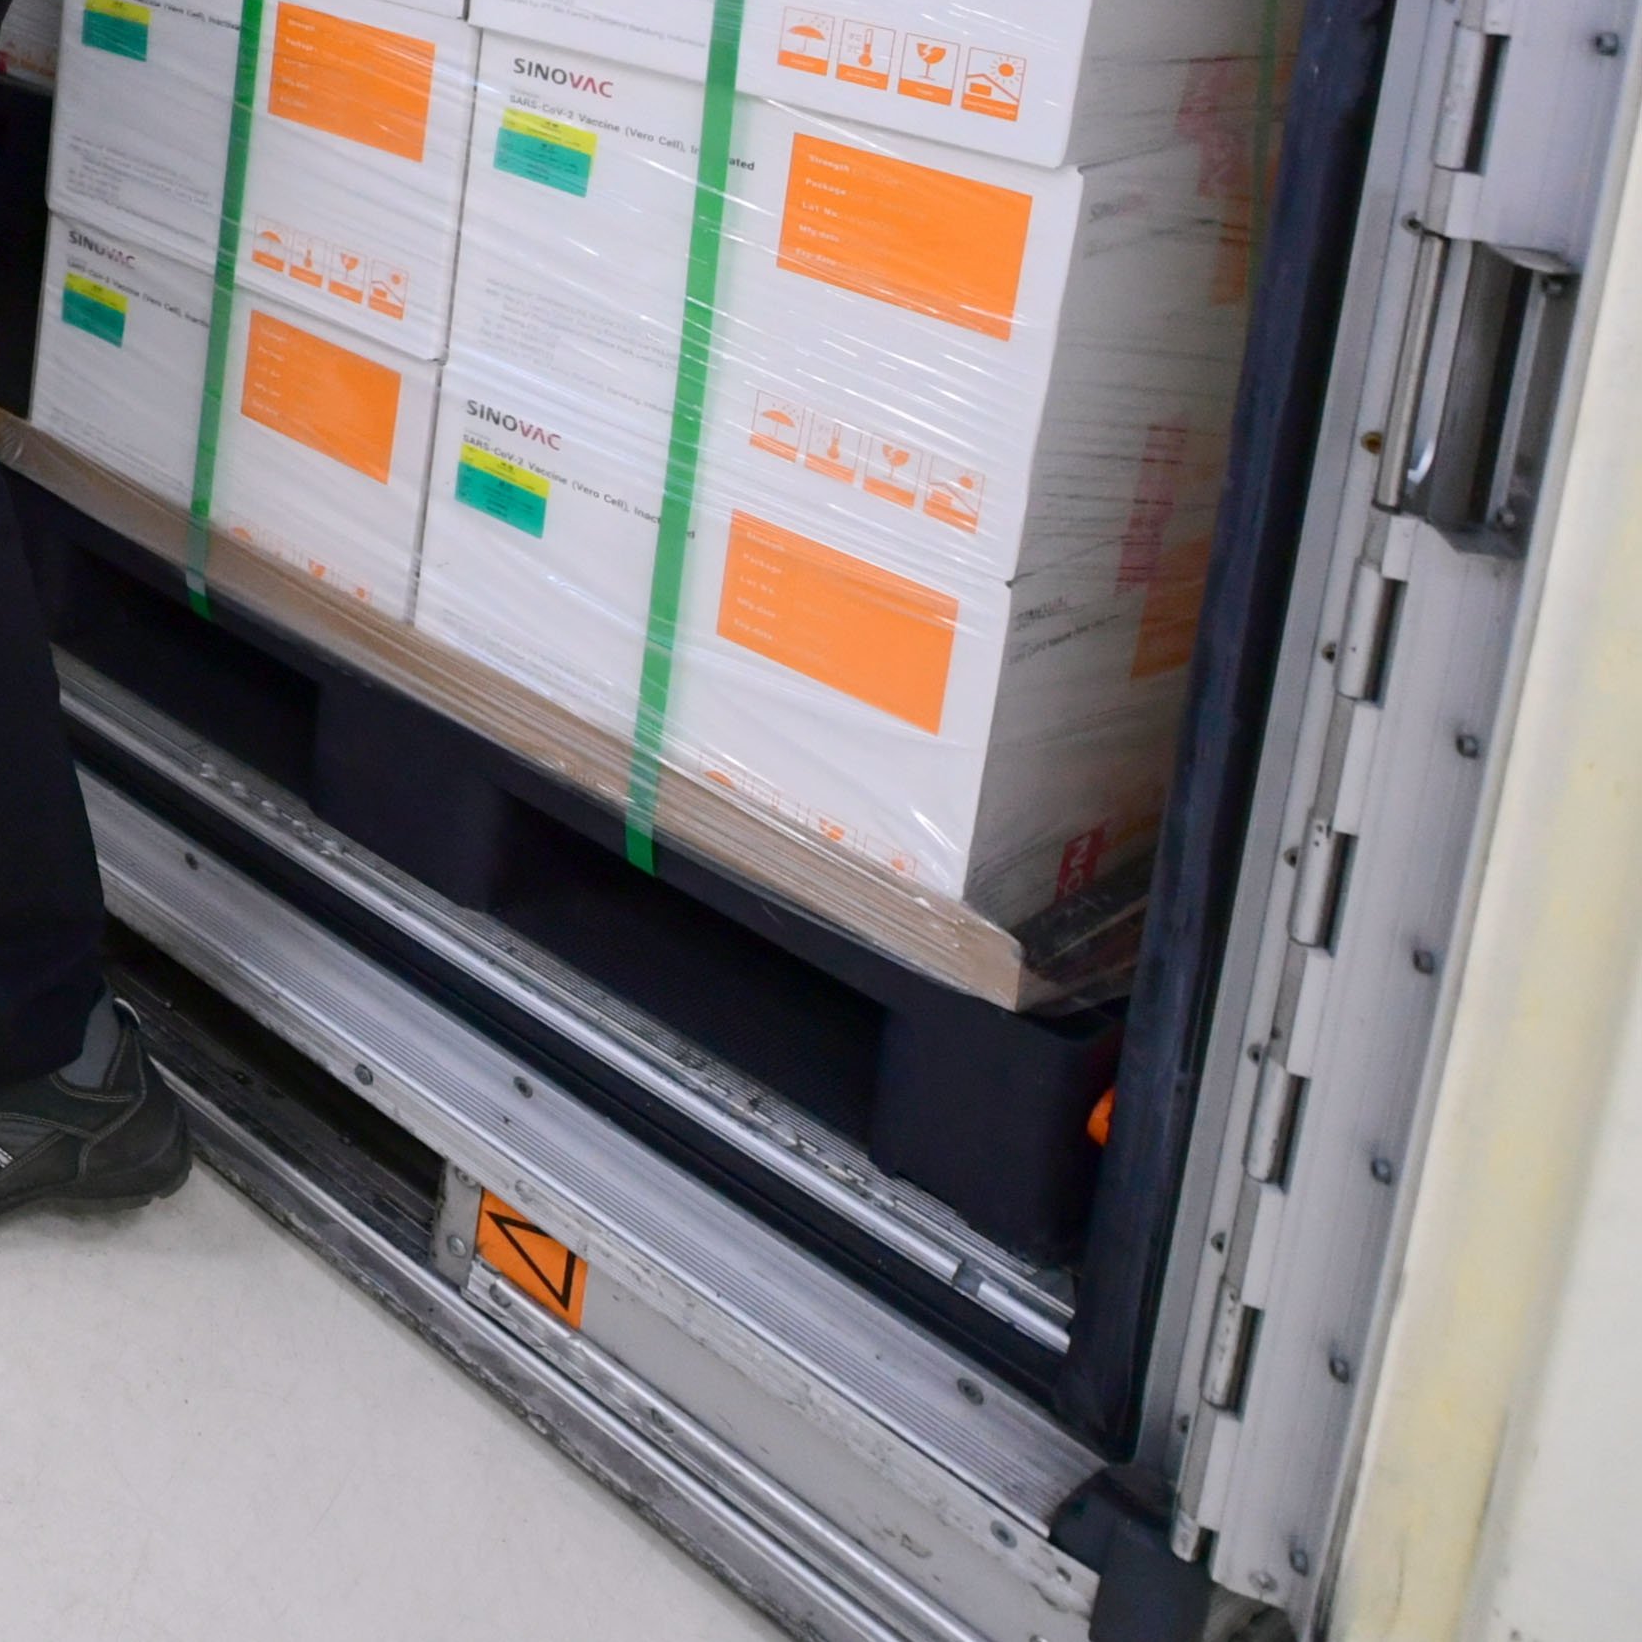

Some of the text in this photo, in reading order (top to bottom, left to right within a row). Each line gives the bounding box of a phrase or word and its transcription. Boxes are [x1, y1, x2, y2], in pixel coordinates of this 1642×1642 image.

[513, 57, 614, 98] SINOVAC
[508, 94, 574, 119] SARS-CoV-2
[579, 113, 621, 133] Vaccine
[625, 125, 655, 143] (Vero
[465, 400, 563, 451] SINOVAC
[463, 433, 524, 465] SARS-CoV-2
[528, 461, 569, 485] Vaccine
[571, 480, 600, 500] (Vero
